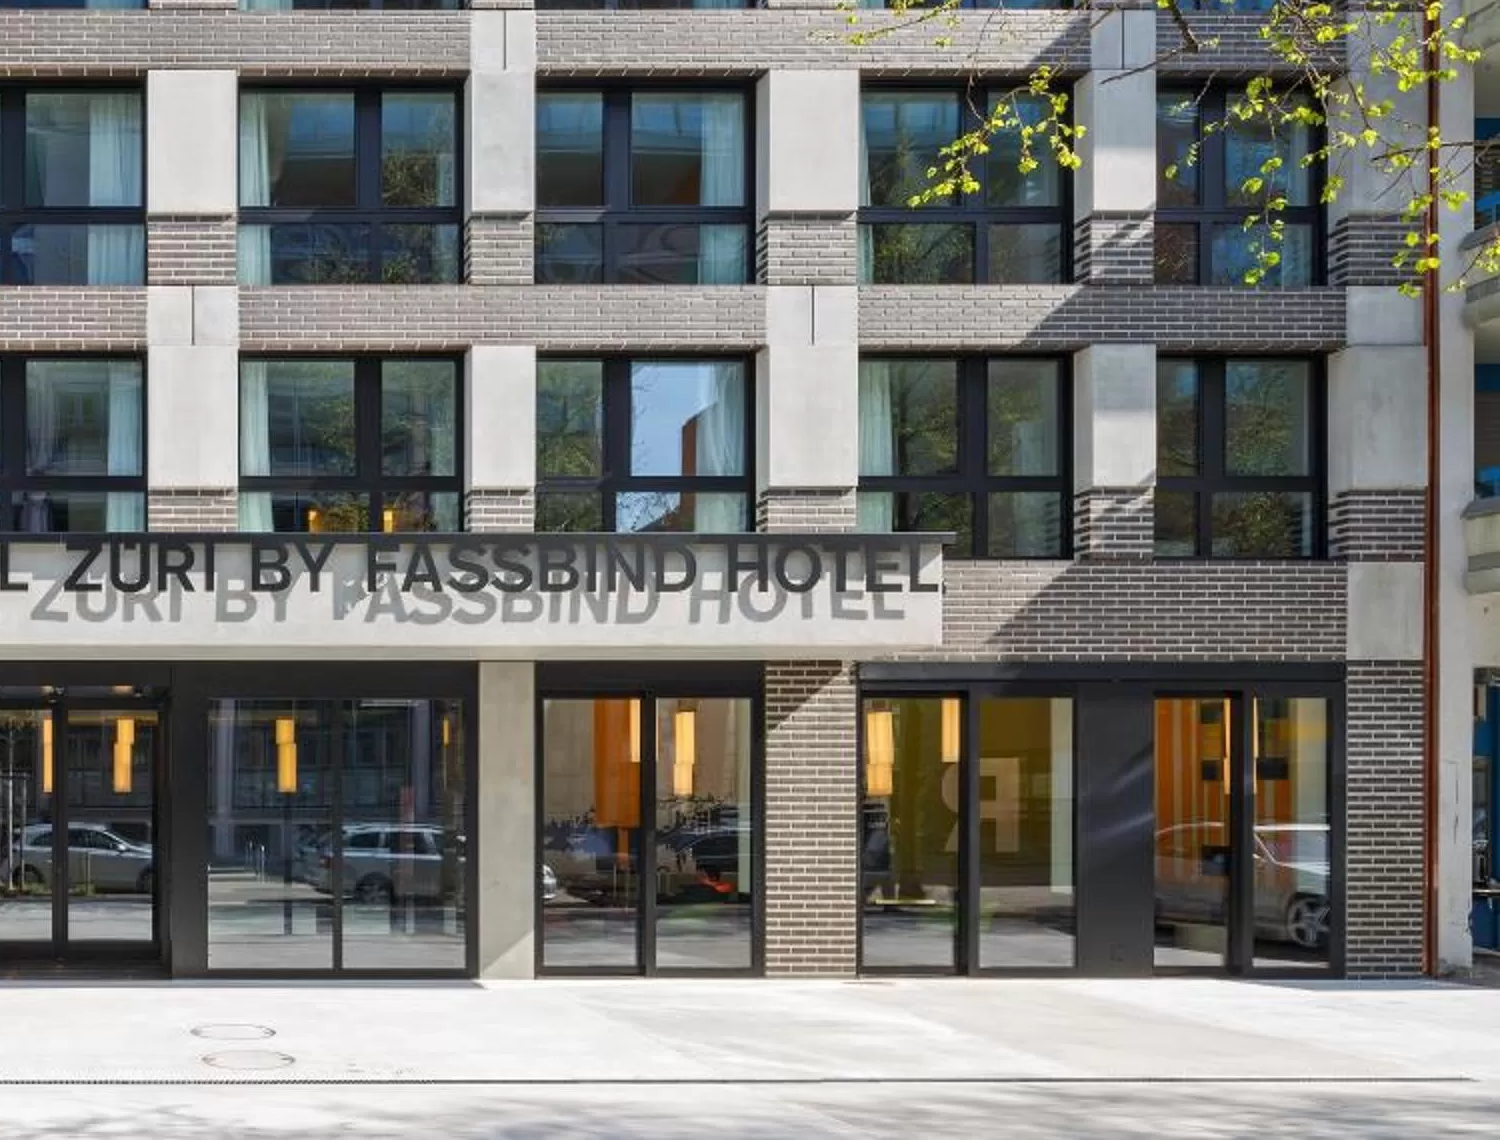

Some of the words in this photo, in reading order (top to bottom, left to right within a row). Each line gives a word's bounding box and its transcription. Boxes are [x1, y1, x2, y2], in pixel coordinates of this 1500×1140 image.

[252, 537, 335, 592] BY
[367, 538, 697, 592] FASSBIND
[728, 538, 939, 592] HOTEL
